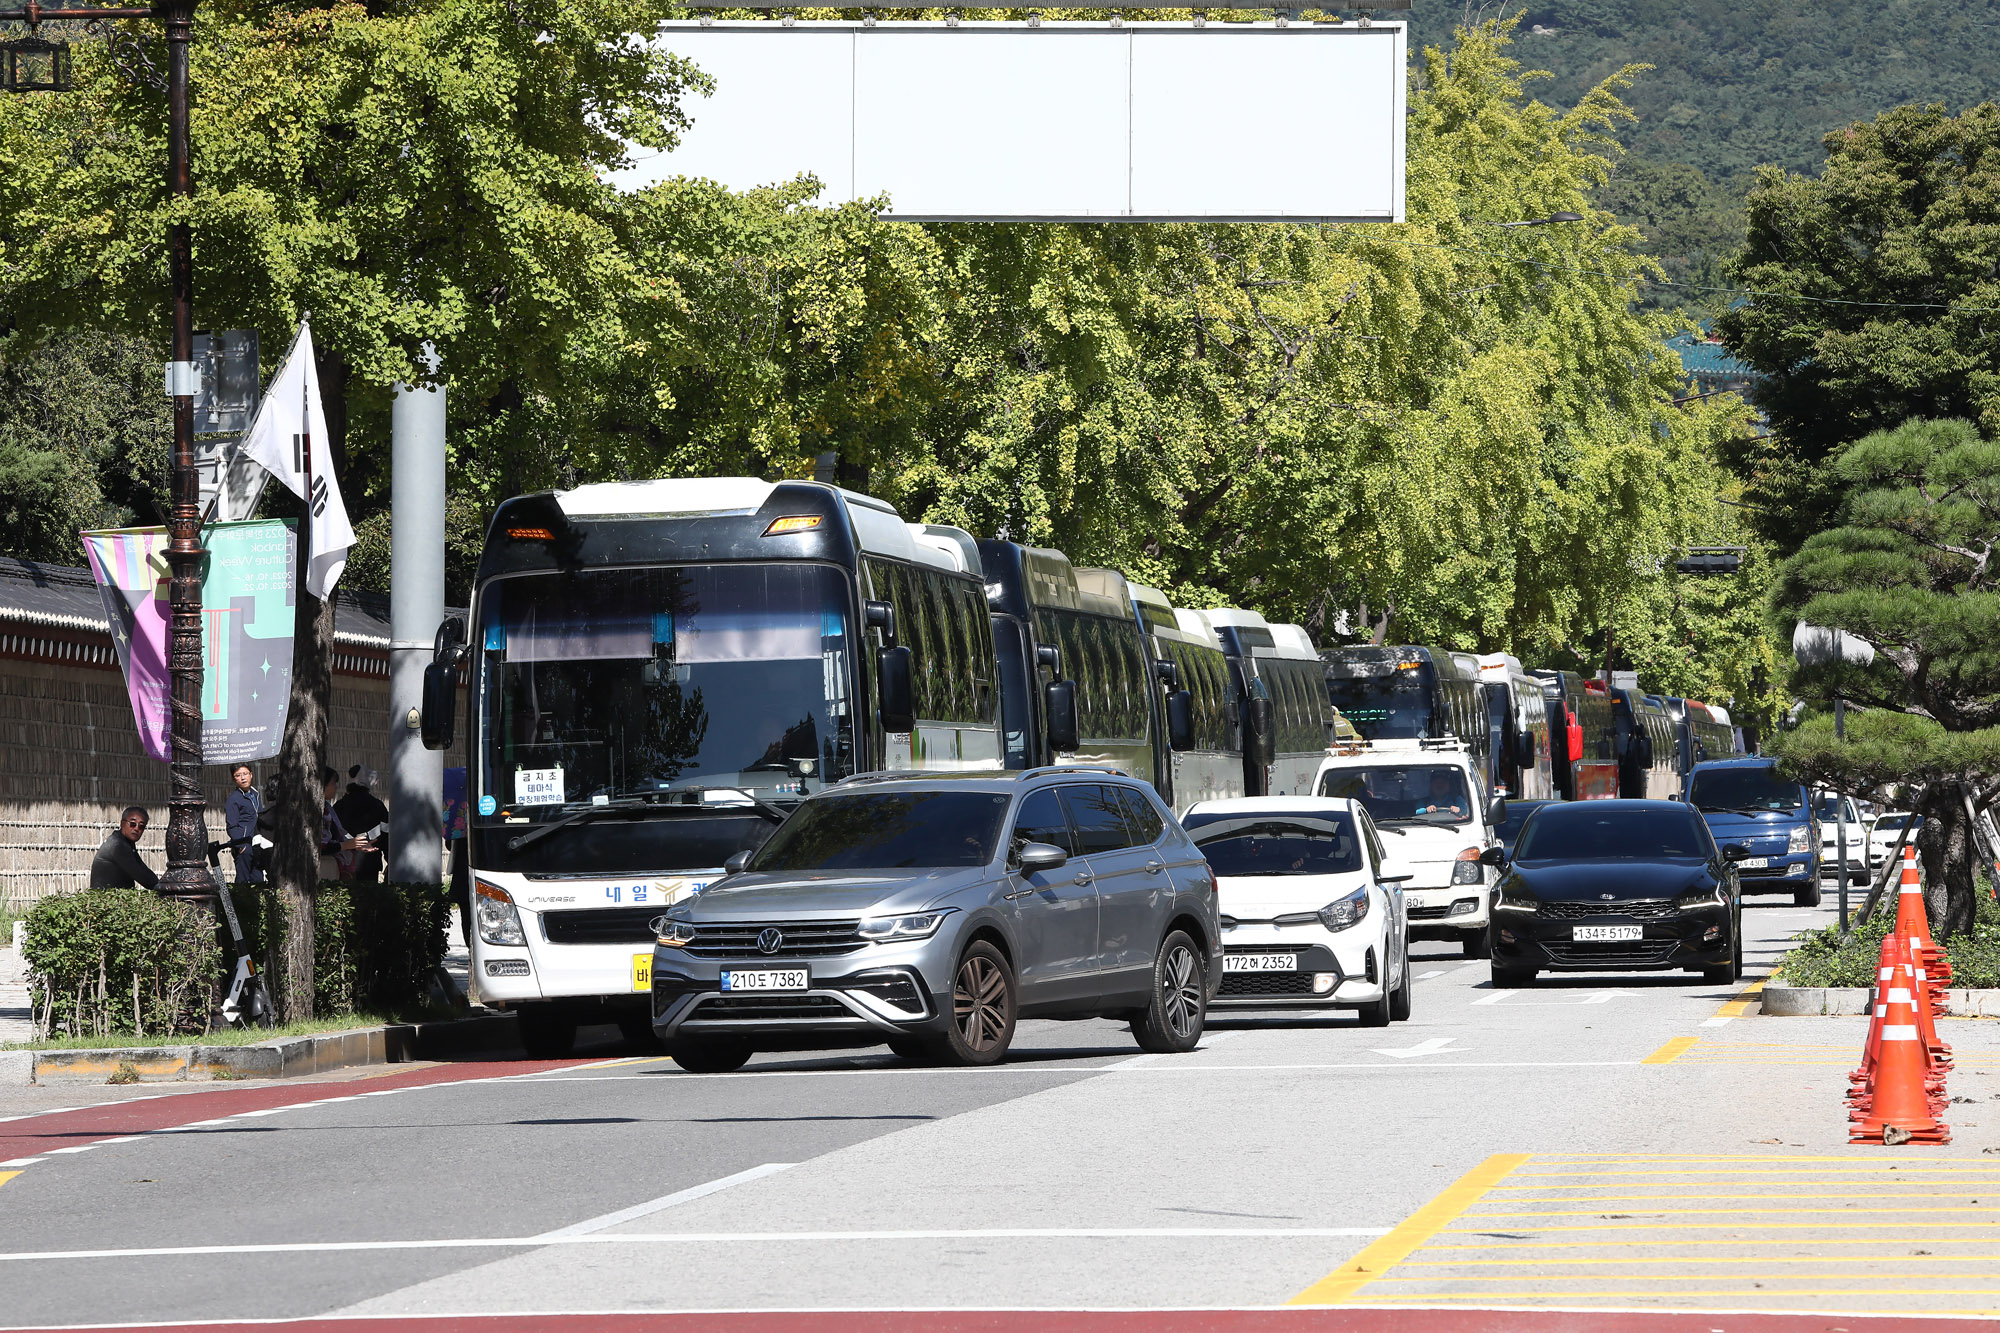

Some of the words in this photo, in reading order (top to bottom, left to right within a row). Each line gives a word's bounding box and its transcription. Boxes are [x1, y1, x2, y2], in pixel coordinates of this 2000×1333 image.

[528, 783, 553, 792] 테마식
[518, 794, 562, 804] 현장체험학습
[1610, 928, 1638, 938] 5179
[1224, 956, 1258, 970] 172허
[1262, 956, 1294, 969] 2352
[732, 973, 767, 988] 210도
[770, 972, 804, 987] 7382
